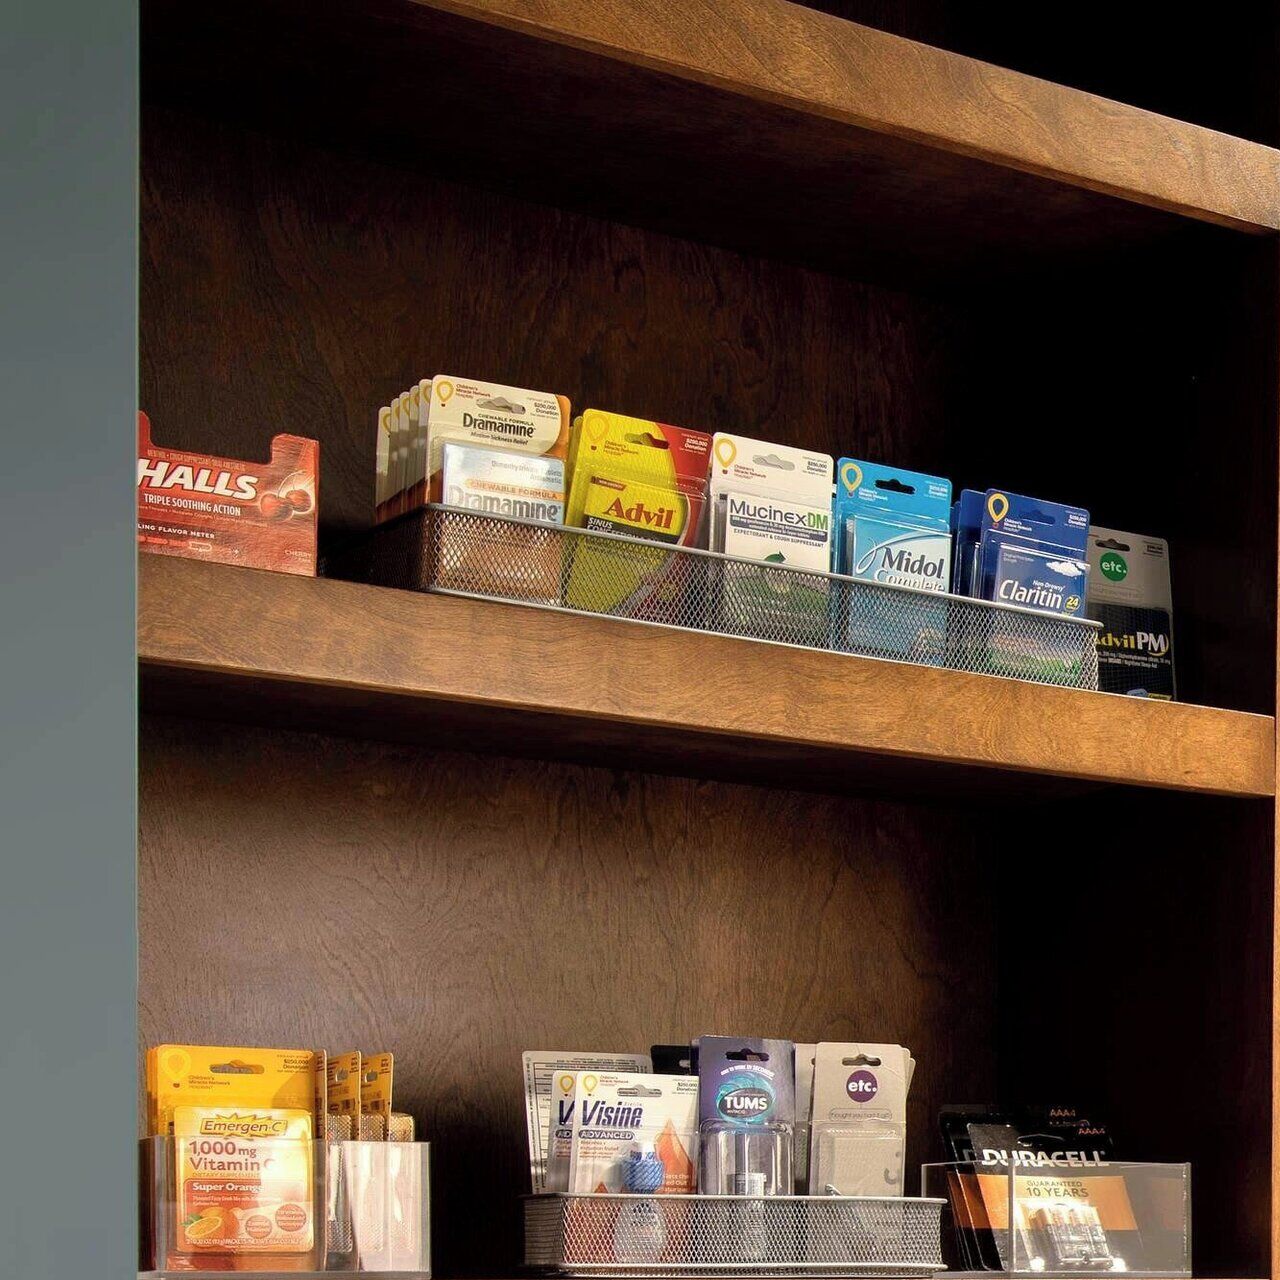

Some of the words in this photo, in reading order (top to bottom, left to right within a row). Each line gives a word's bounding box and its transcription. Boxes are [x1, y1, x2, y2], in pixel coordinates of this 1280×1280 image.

[463, 413, 534, 438] Dramamine
[478, 413, 507, 423] CHEWABLE
[509, 418, 534, 427] FORMULA
[471, 431, 490, 440] Motion
[491, 435, 513, 444] Sickness
[138, 458, 259, 501] HALLS
[518, 487, 558, 500] FORMULA
[144, 493, 171, 507] TRIPLE
[172, 497, 213, 513] SOOTHING
[212, 504, 241, 517] ACTION
[448, 484, 562, 522] Dramamine
[602, 497, 675, 529] Advil
[587, 516, 614, 530] SINUS
[158, 526, 188, 536] FLAVOR
[190, 530, 215, 539] METER
[733, 528, 769, 539] EXPECTORANT
[774, 534, 791, 544] COUGH
[791, 538, 825, 549] SUPPRESSANT
[881, 545, 945, 580] Midol
[1100, 560, 1128, 575] etc.
[999, 579, 1063, 609] Claritin
[1066, 595, 1080, 607] 24
[1136, 631, 1168, 652] PM
[848, 1078, 878, 1093] etc.
[724, 1095, 769, 1110] TUMS
[581, 1099, 643, 1127] Visine
[204, 1120, 284, 1134] Emergen-C
[580, 1130, 633, 1141] ADVANCED
[188, 1140, 237, 1158] 1,000
[238, 1146, 257, 1159] mg
[189, 1156, 261, 1172] Vitamin
[981, 1149, 1110, 1168] DURACELL
[192, 1182, 223, 1194] Super
[1026, 1179, 1083, 1188] GUARANTEED
[1026, 1186, 1042, 1198] 10
[1046, 1186, 1090, 1199] YEARS
